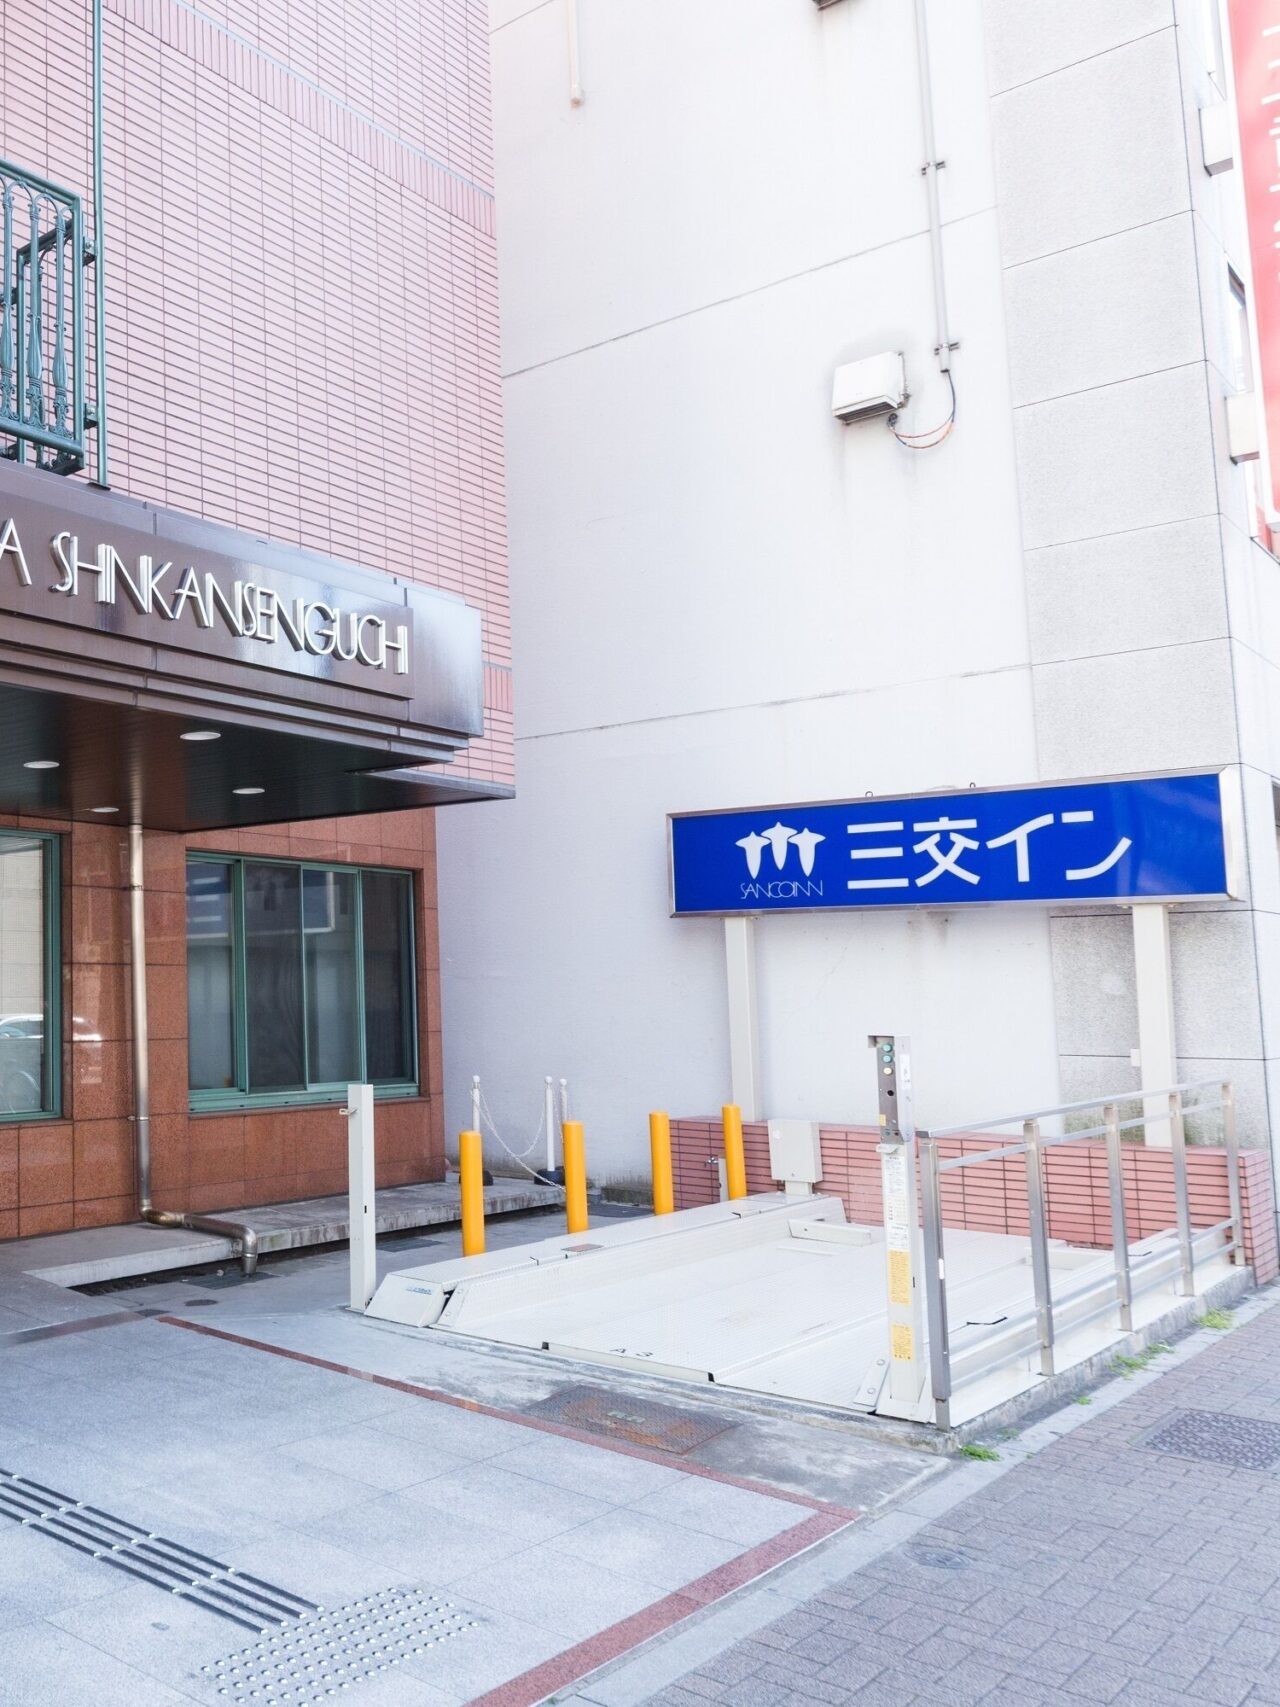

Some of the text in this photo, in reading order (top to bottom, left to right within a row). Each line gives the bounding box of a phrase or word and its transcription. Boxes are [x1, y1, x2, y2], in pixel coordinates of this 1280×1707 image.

[50, 531, 409, 675] SHINKANSENGUCHI
[846, 810, 1132, 888] 三交イン
[740, 879, 825, 899] SANCOINN
